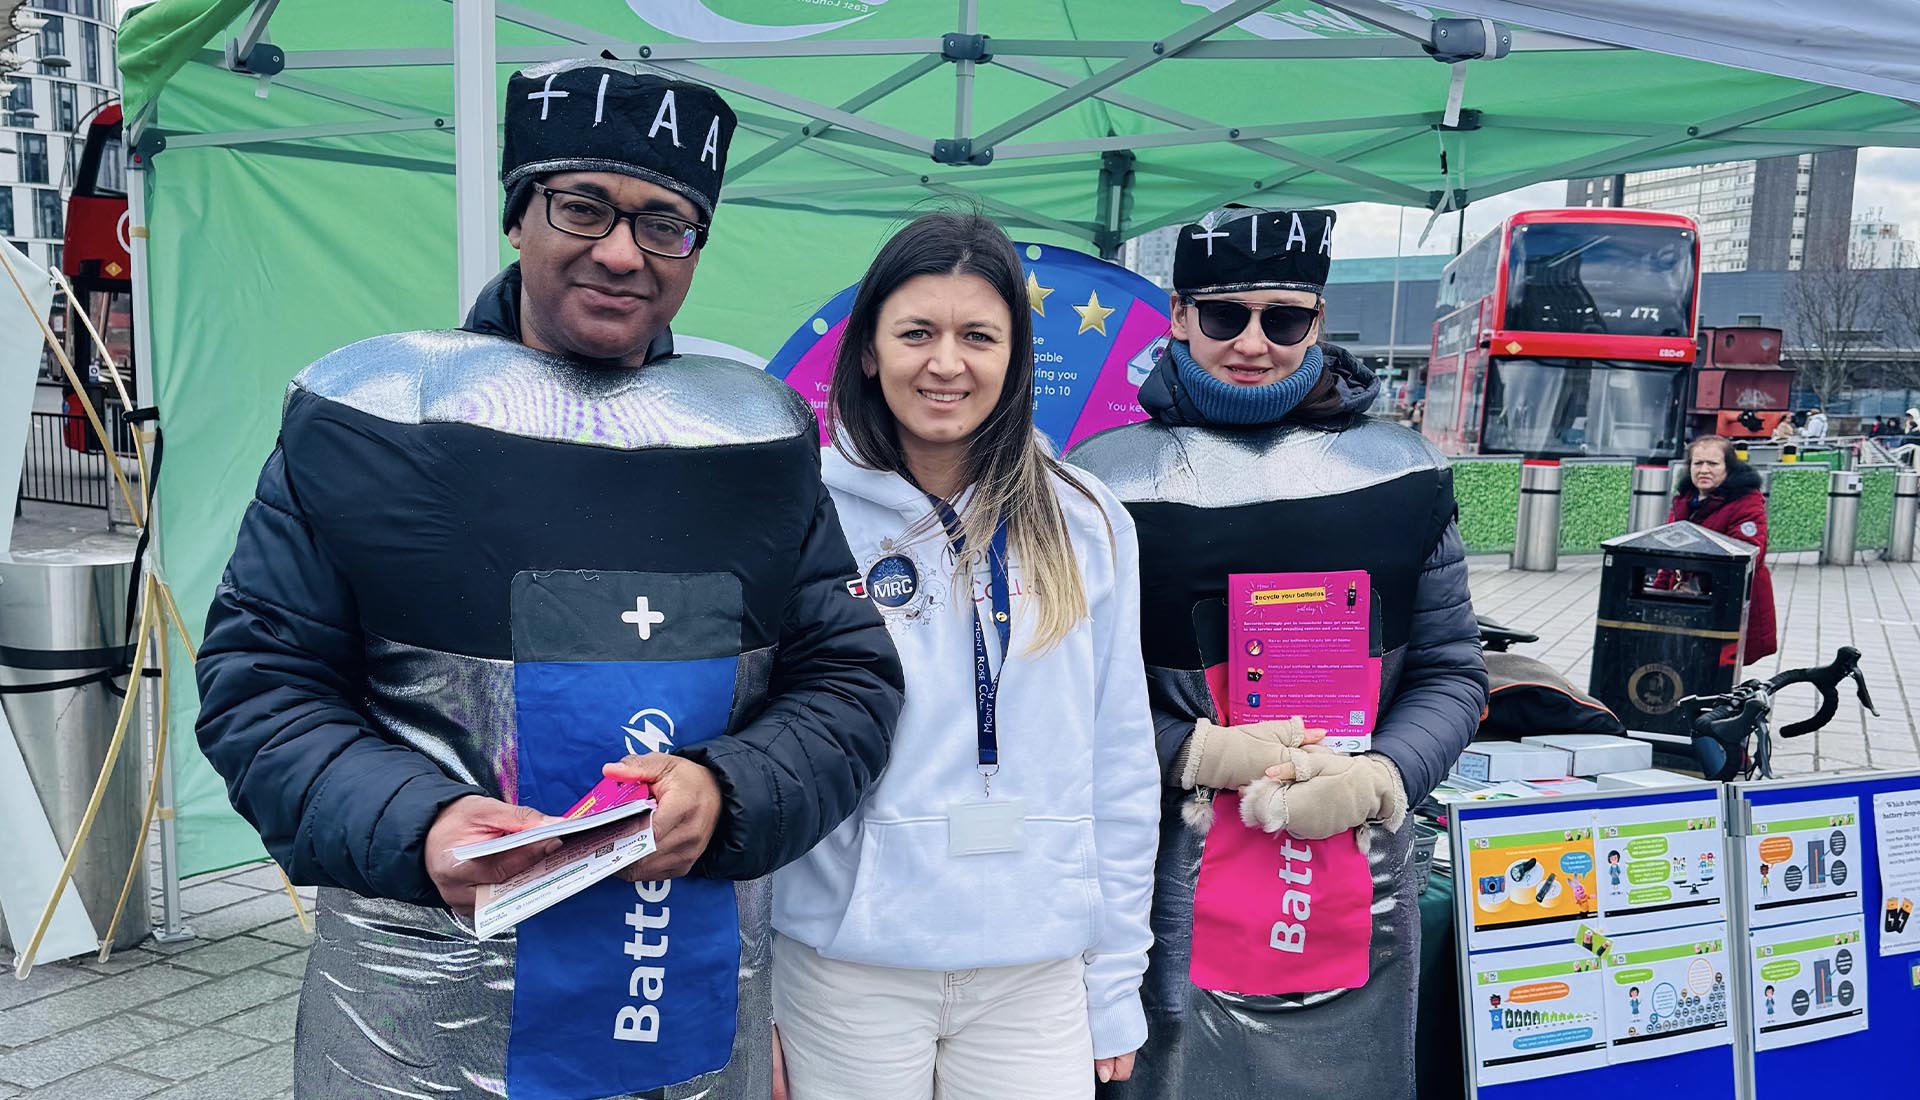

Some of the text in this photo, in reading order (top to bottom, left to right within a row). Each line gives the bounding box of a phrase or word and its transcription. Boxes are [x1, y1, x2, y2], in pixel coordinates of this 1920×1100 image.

[1057, 371, 1077, 382] you
[1044, 384, 1055, 395] to
[1059, 385, 1071, 397] 10
[1107, 401, 1126, 412] You
[873, 577, 913, 598] MRC
[975, 621, 983, 653] MONT
[977, 656, 986, 681] ROSE
[983, 702, 993, 733] MONT
[1269, 839, 1313, 954] Batt
